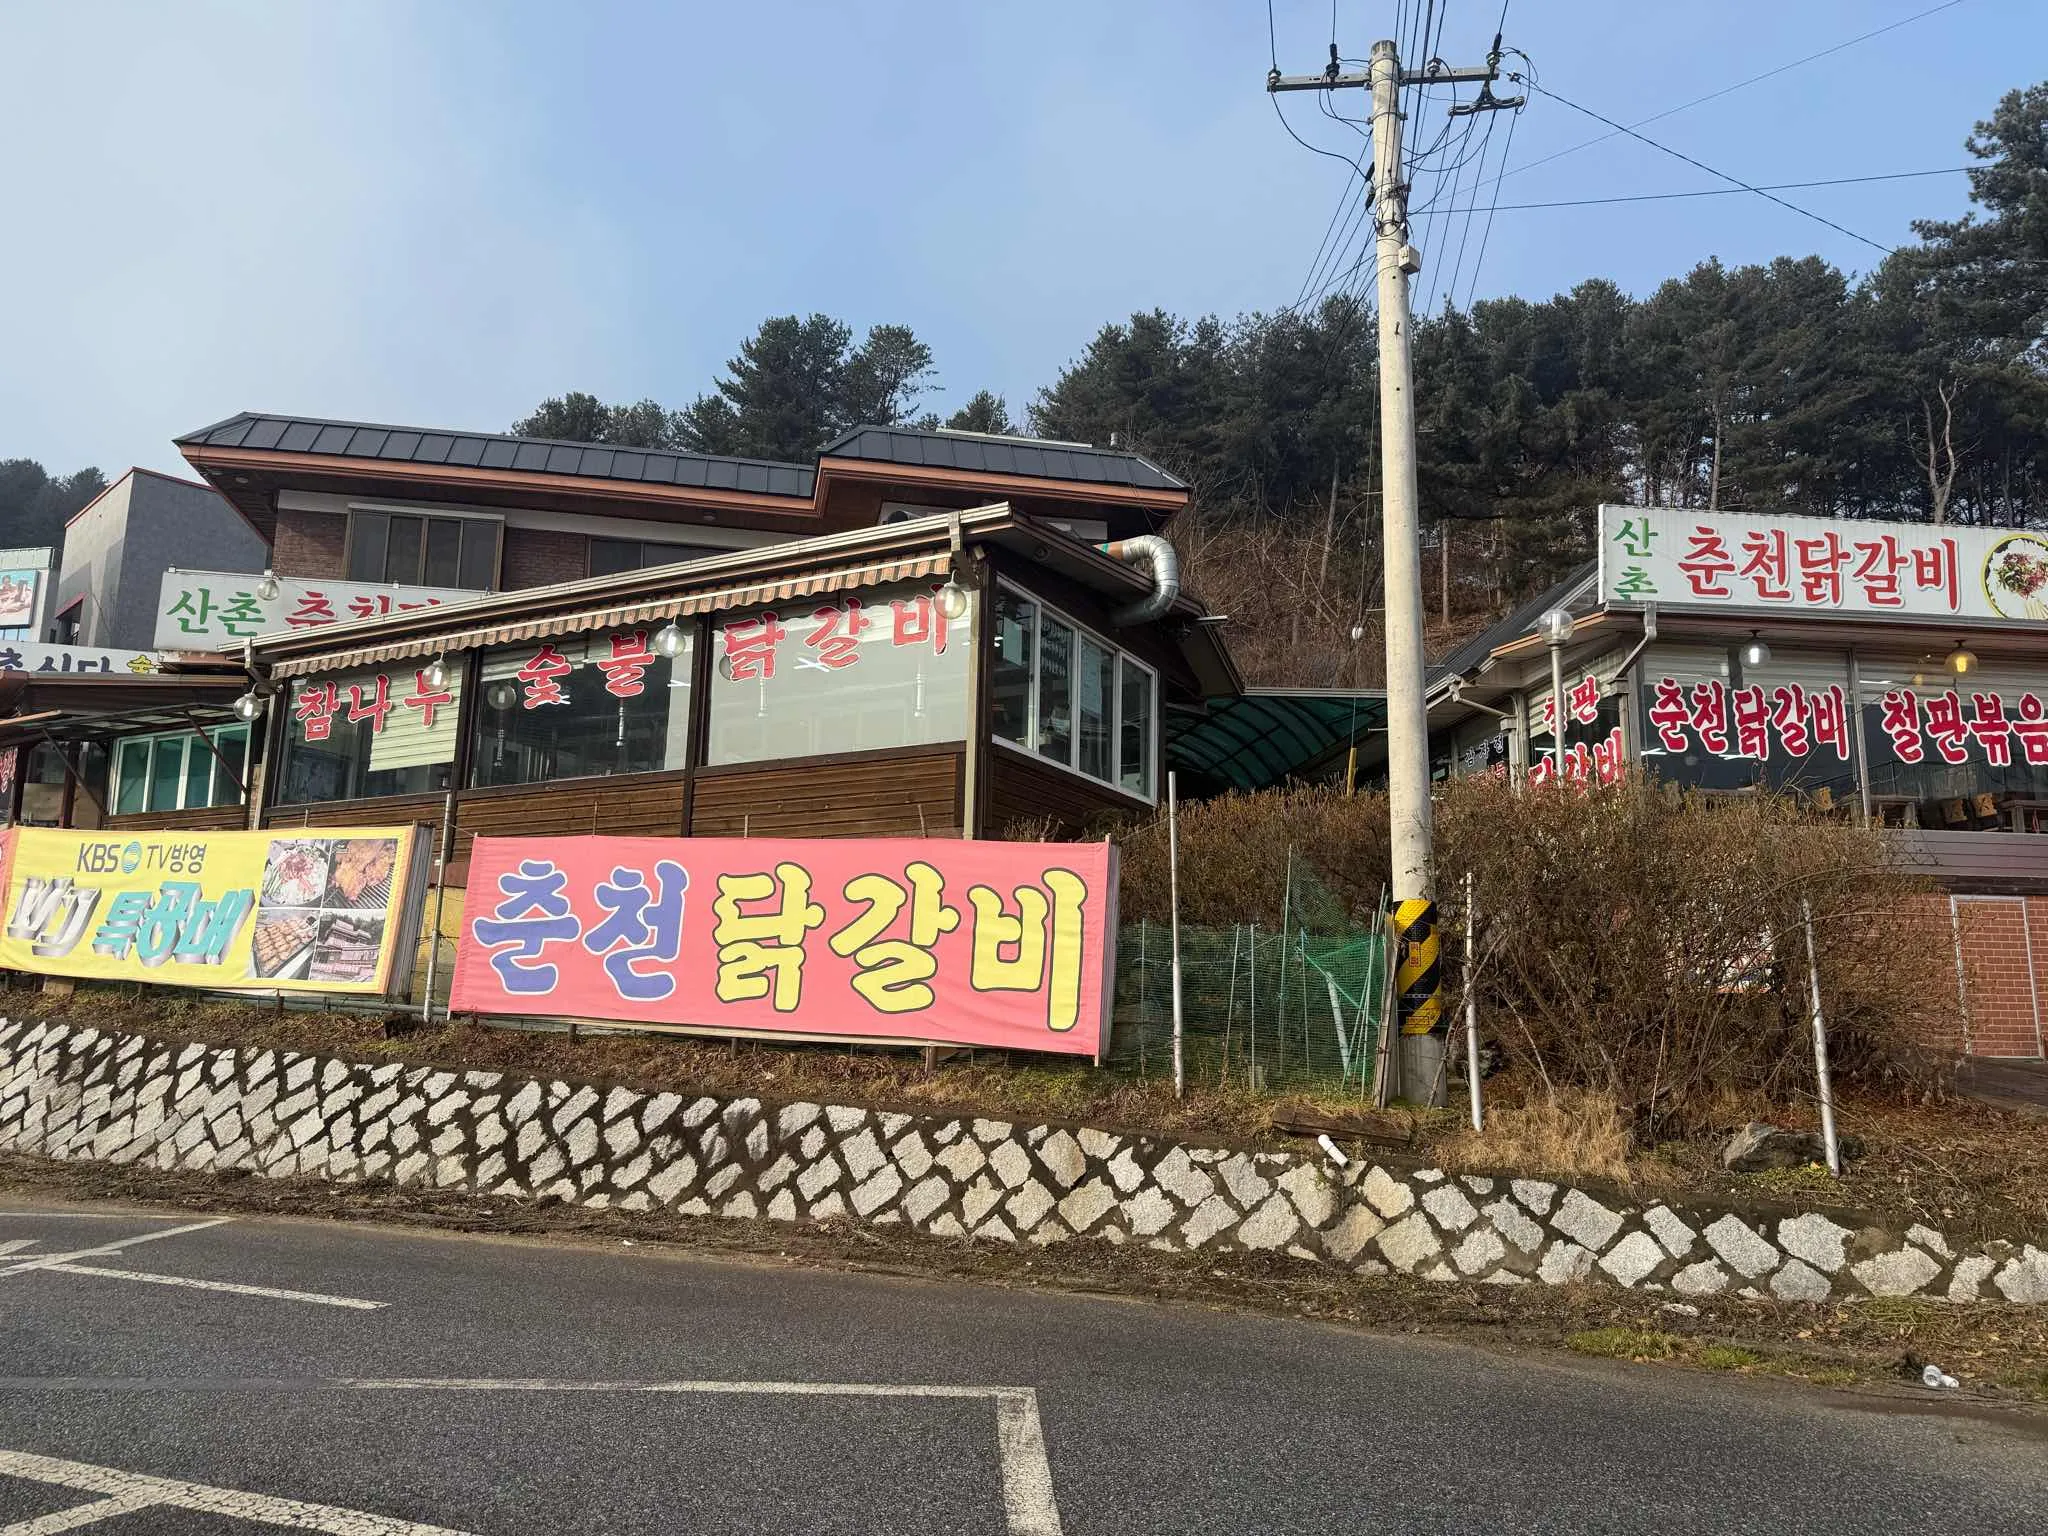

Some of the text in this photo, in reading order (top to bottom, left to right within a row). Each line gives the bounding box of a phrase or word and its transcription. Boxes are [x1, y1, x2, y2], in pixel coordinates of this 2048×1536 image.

[166, 586, 267, 638] 산촌
[1677, 524, 1963, 614] 춘천닭갈비
[722, 582, 950, 683] 닭갈비
[1648, 676, 2048, 768] 춘천닭갈비 철판볶음
[77, 842, 208, 875] KBS TV방영
[91, 880, 257, 968] 특공대
[472, 857, 1090, 1033] 춘천 닭갈비
